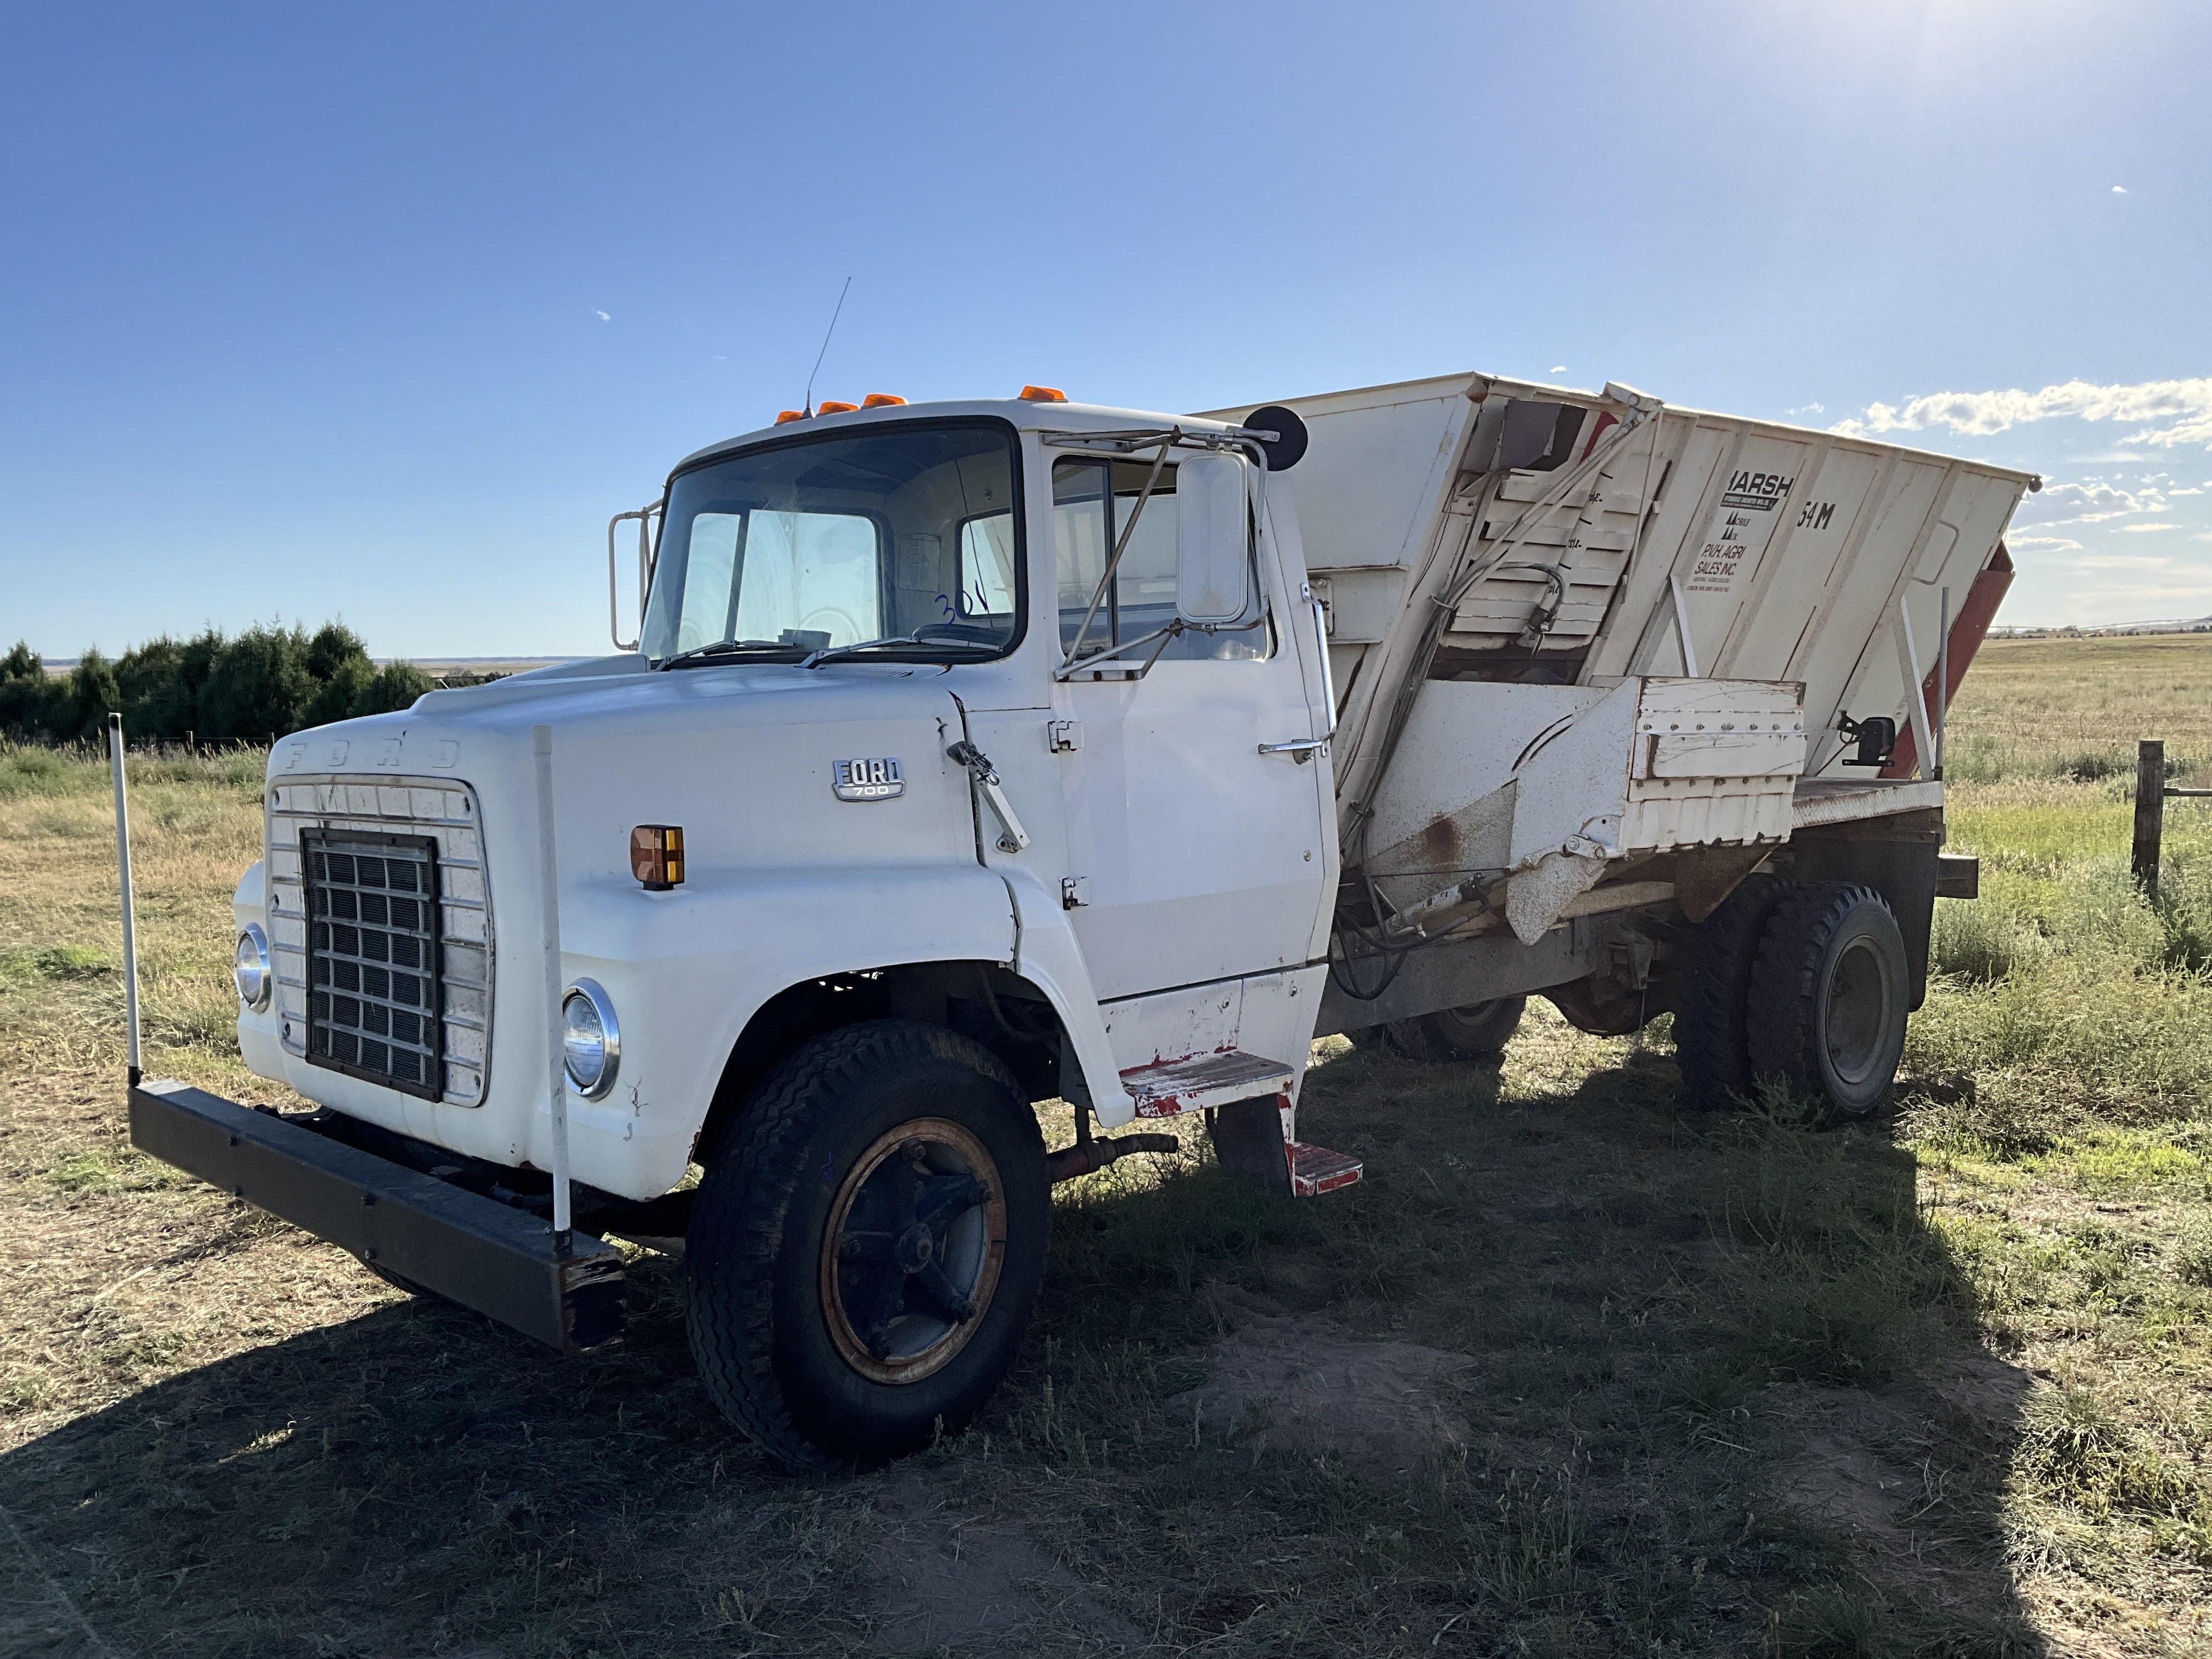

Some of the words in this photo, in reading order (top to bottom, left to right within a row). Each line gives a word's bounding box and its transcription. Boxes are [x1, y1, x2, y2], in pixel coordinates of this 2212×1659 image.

[1721, 545, 1747, 559] AGRI
[1695, 561, 1722, 575] SALES
[284, 738, 460, 769] FORD
[833, 758, 902, 787] FORD
[853, 786, 889, 795] 700
